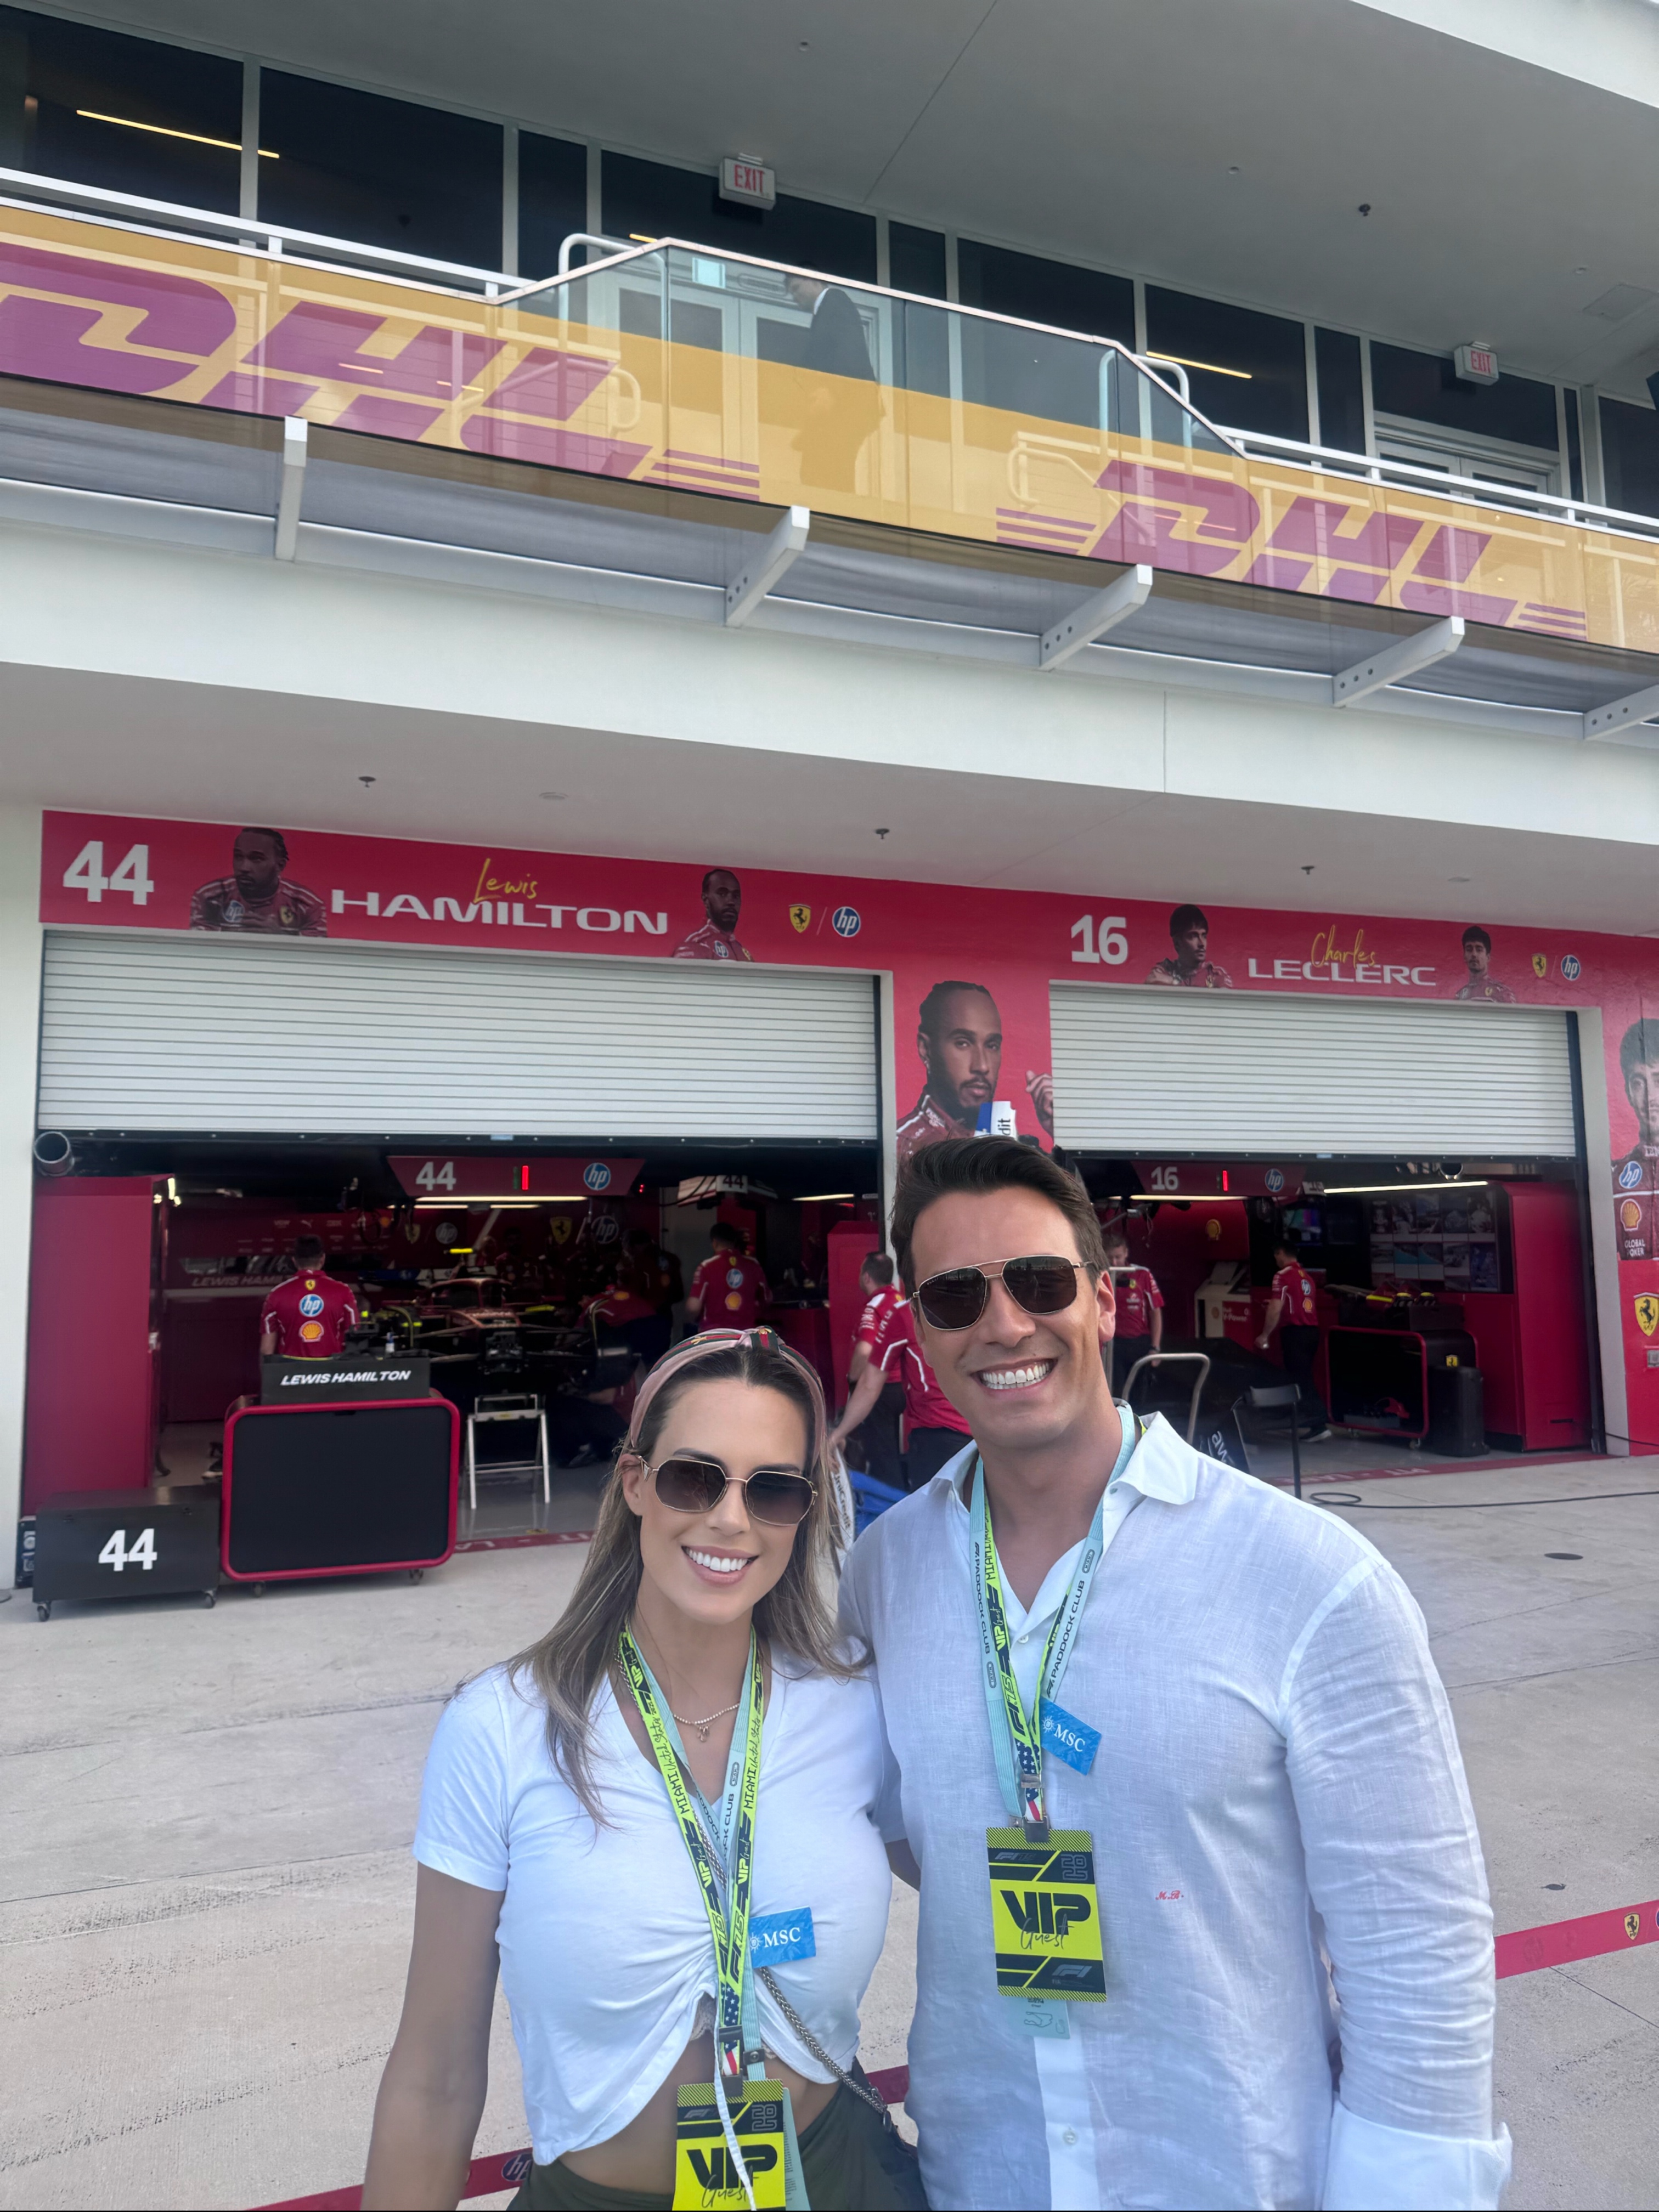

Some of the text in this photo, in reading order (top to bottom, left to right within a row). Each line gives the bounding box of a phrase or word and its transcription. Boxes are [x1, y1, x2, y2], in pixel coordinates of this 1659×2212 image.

[733, 163, 766, 193] EXIT
[0, 242, 654, 480] DHL
[1470, 350, 1491, 375] EXIT
[1087, 459, 1518, 626] DHL
[63, 840, 155, 906] 44
[473, 857, 538, 903] Lewis
[331, 889, 668, 935] HAMILTON
[835, 907, 857, 937] hp
[1070, 914, 1128, 965] 16
[1310, 924, 1376, 969] Charles
[1248, 958, 1436, 986] LECLERC
[1562, 954, 1579, 981] hp
[415, 1161, 456, 1191] 44
[586, 1162, 610, 1190] hp
[1150, 1166, 1179, 1191] 16
[1266, 1168, 1282, 1192] hp
[1621, 1161, 1640, 1189] hp
[303, 1294, 321, 1317] hp
[280, 1370, 411, 1386] LEWIS HAMILTON
[99, 1528, 157, 1572] 44
[974, 1558, 984, 1619] PADDOCK
[981, 1620, 990, 1655] CLUB
[990, 1605, 1006, 1651] VIP Guest
[1051, 1615, 1075, 1678] PADDOCK
[1071, 1580, 1085, 1614] CLUB
[630, 1665, 645, 1688] VIP
[649, 1716, 668, 1743] States
[1053, 1723, 1086, 1752] MSC
[656, 1740, 678, 1771] United
[748, 1739, 761, 1768] United
[667, 1770, 691, 1814] MIAMI
[743, 1767, 757, 1809] MIAMI
[695, 1787, 720, 1842] ADDOCK
[725, 1794, 735, 1826] CLUB
[690, 1842, 713, 1889] VIP Guest
[737, 1836, 751, 1885] VIP Guest
[1000, 1889, 1092, 1936] VIP
[763, 1927, 801, 1948] MSC
[1020, 1913, 1075, 1950] Guest
[686, 2144, 778, 2190] VIP
